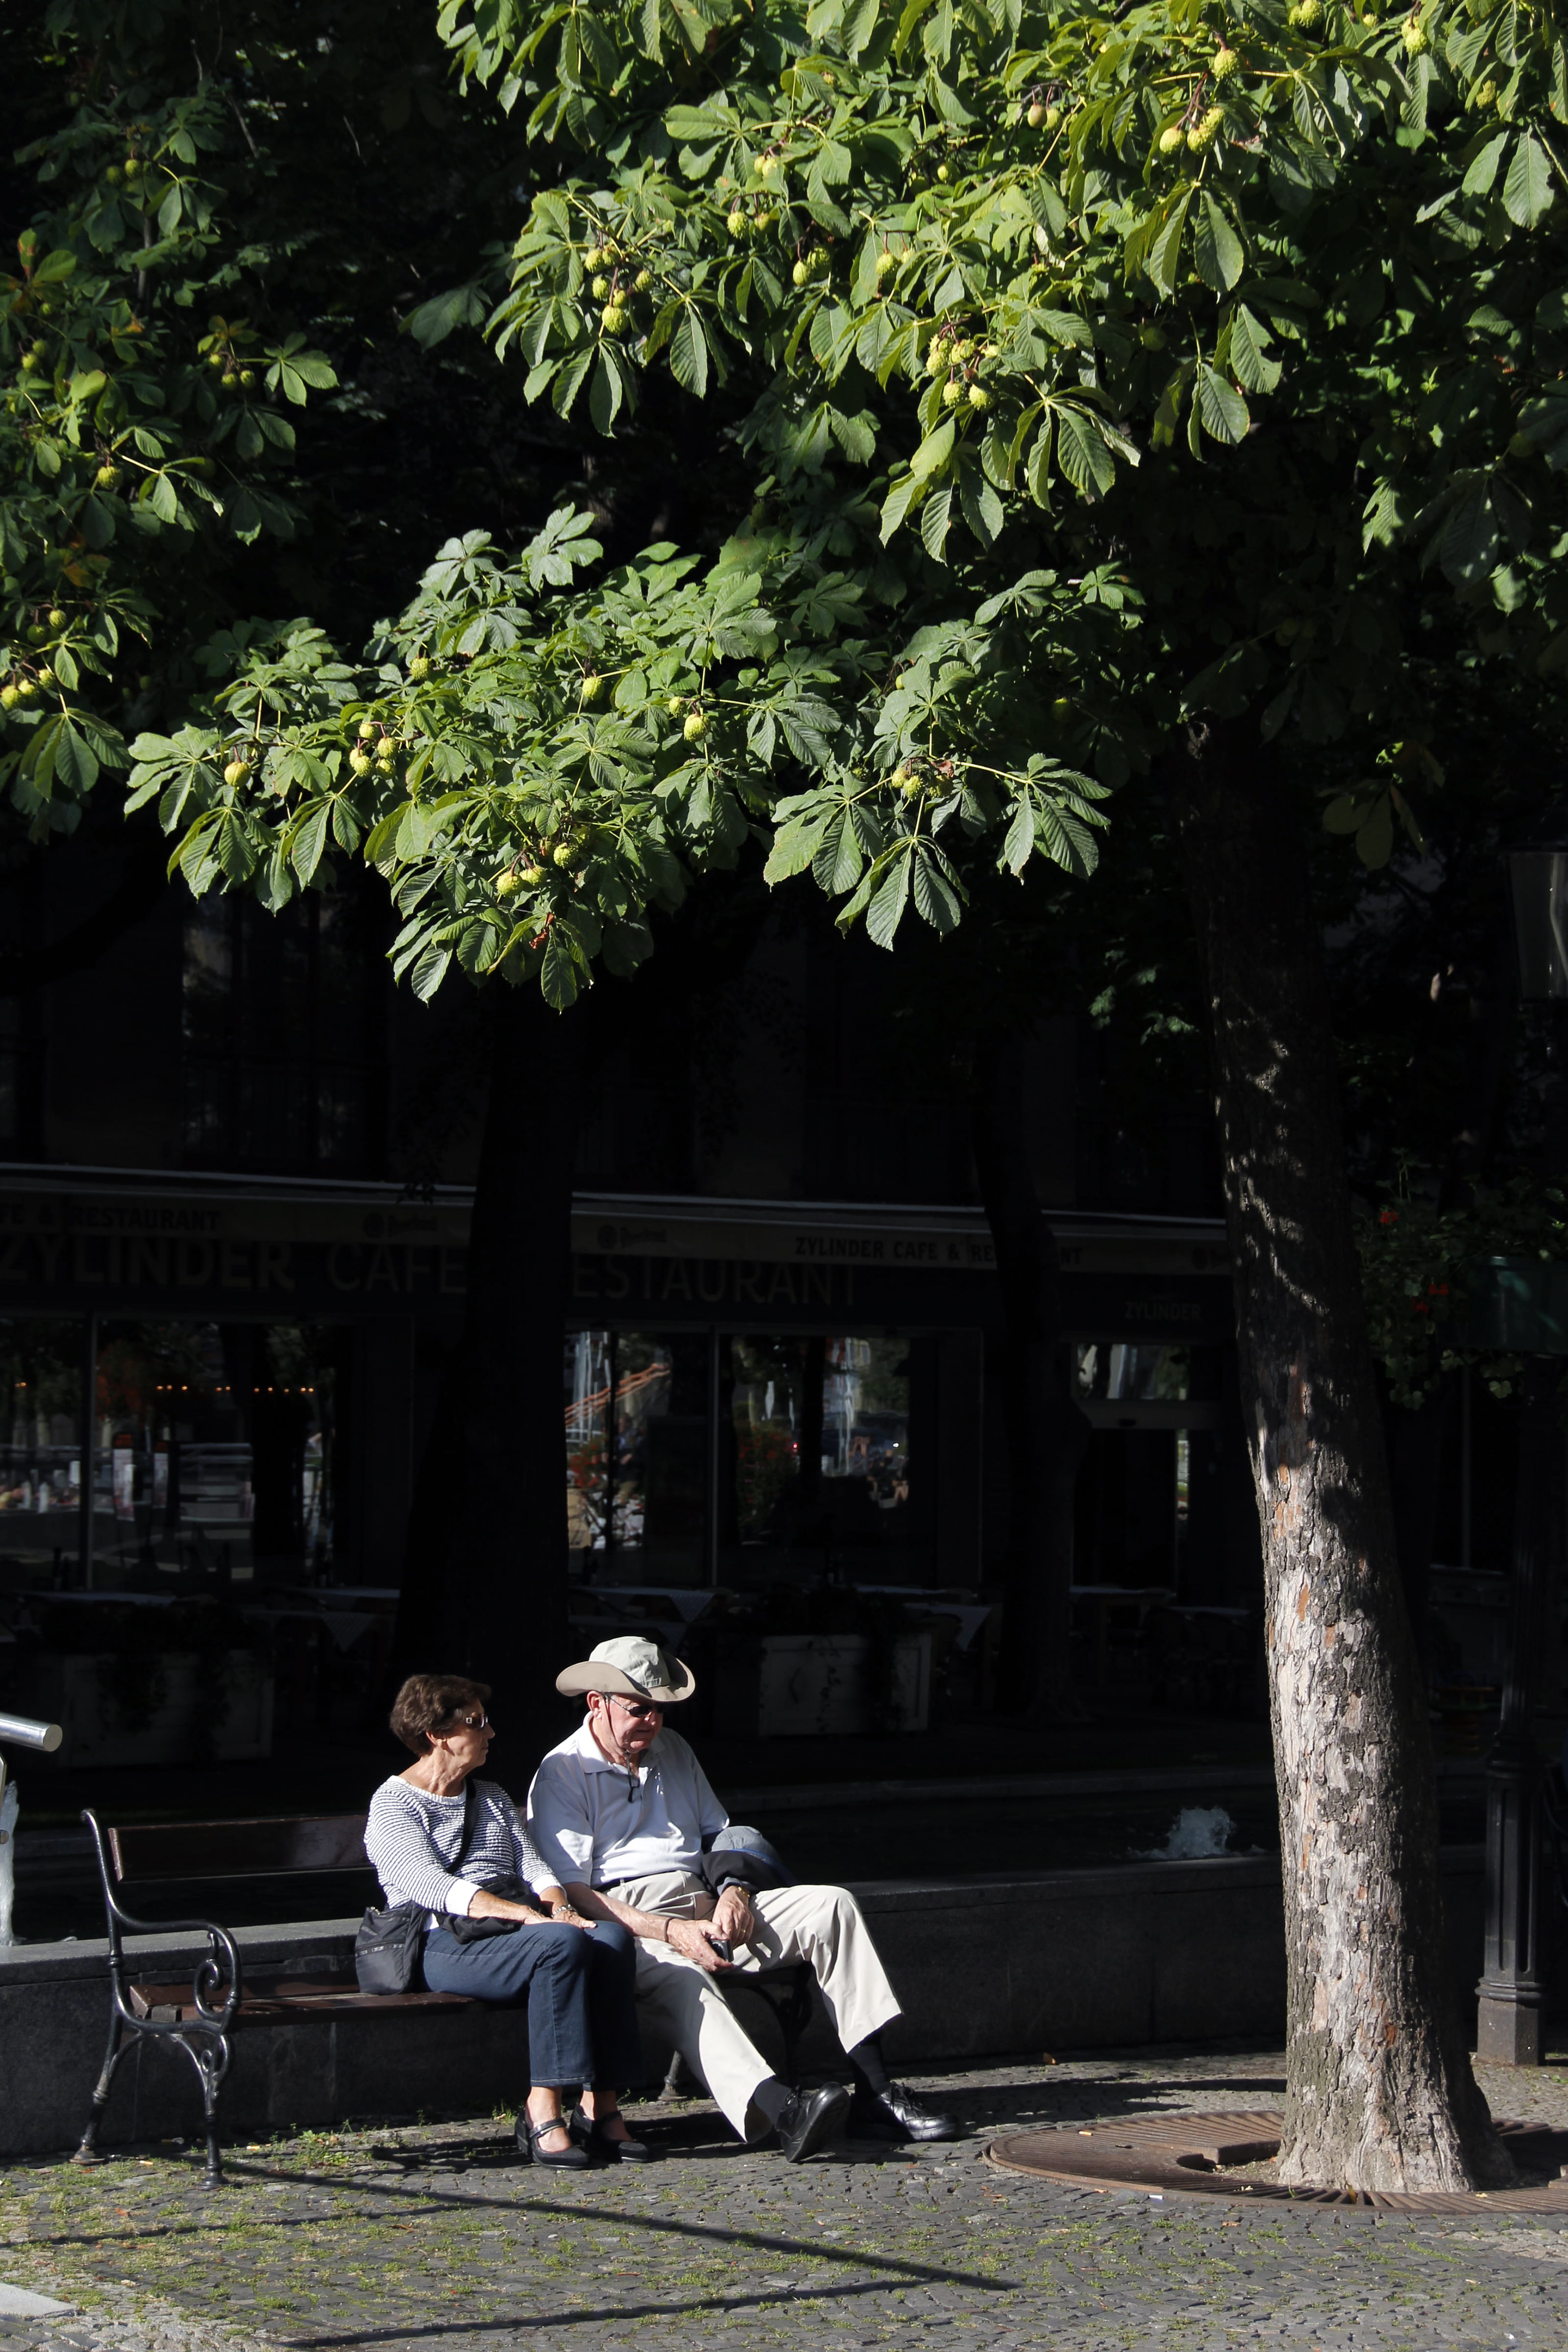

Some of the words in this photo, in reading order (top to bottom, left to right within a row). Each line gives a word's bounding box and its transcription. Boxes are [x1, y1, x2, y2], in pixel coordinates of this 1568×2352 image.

[39, 1203, 53, 1225] &
[70, 1206, 220, 1230] RESTAURANT
[795, 1237, 884, 1258] ZYLINDER
[893, 1241, 937, 1260] CAFE
[948, 1243, 960, 1261] &
[0, 1233, 296, 1293] ZYLINDER
[326, 1242, 467, 1294] CAFE
[572, 1254, 855, 1306] ESTAURANT
[1125, 1301, 1201, 1321] ZYLINDER
